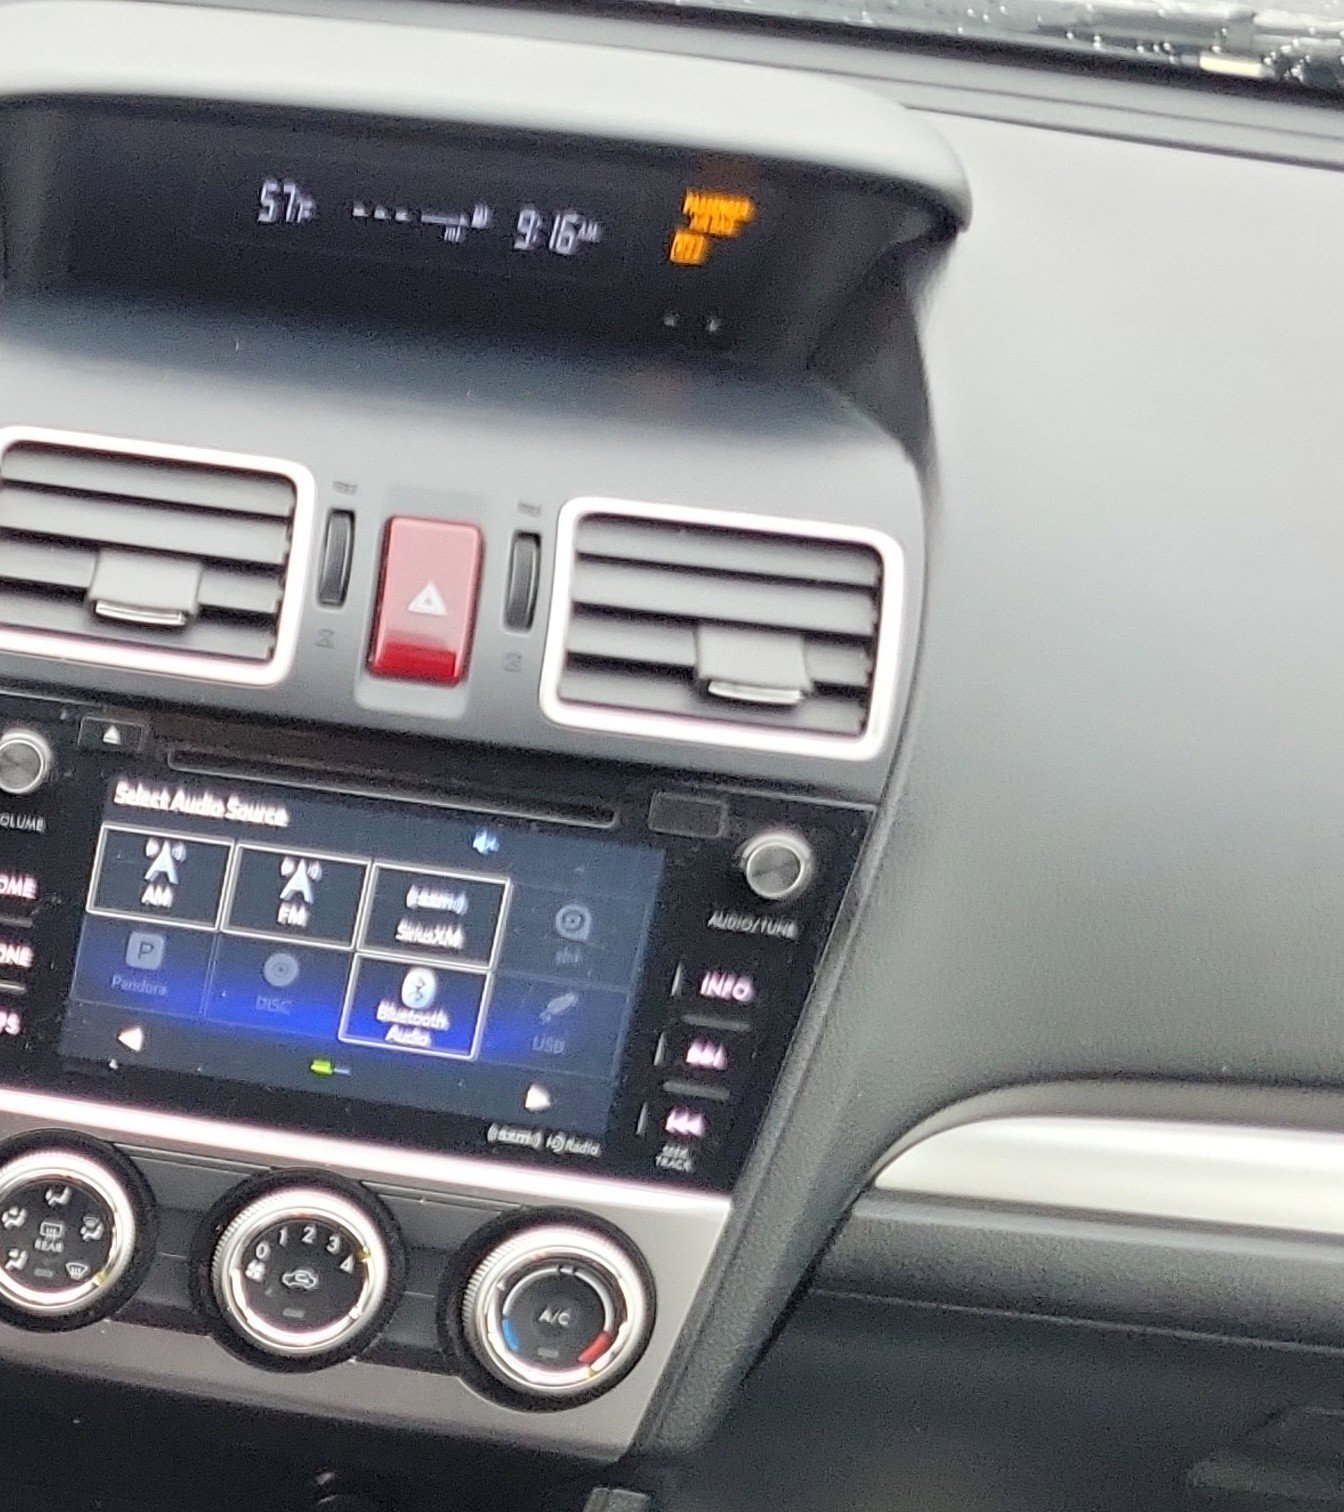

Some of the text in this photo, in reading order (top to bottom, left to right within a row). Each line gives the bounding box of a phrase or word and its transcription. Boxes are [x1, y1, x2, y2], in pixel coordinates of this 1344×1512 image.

[113, 779, 291, 828] Select Audio Source
[141, 882, 175, 909] AM
[277, 901, 310, 928] FM
[700, 970, 758, 1002] INFO
[278, 1226, 288, 1247] 1
[301, 1225, 317, 1245] 2
[326, 1235, 341, 1255] 3
[34, 1238, 65, 1254] REAR
[255, 1241, 270, 1260] 0
[339, 1255, 354, 1274] 4
[538, 1305, 572, 1327] A/C
